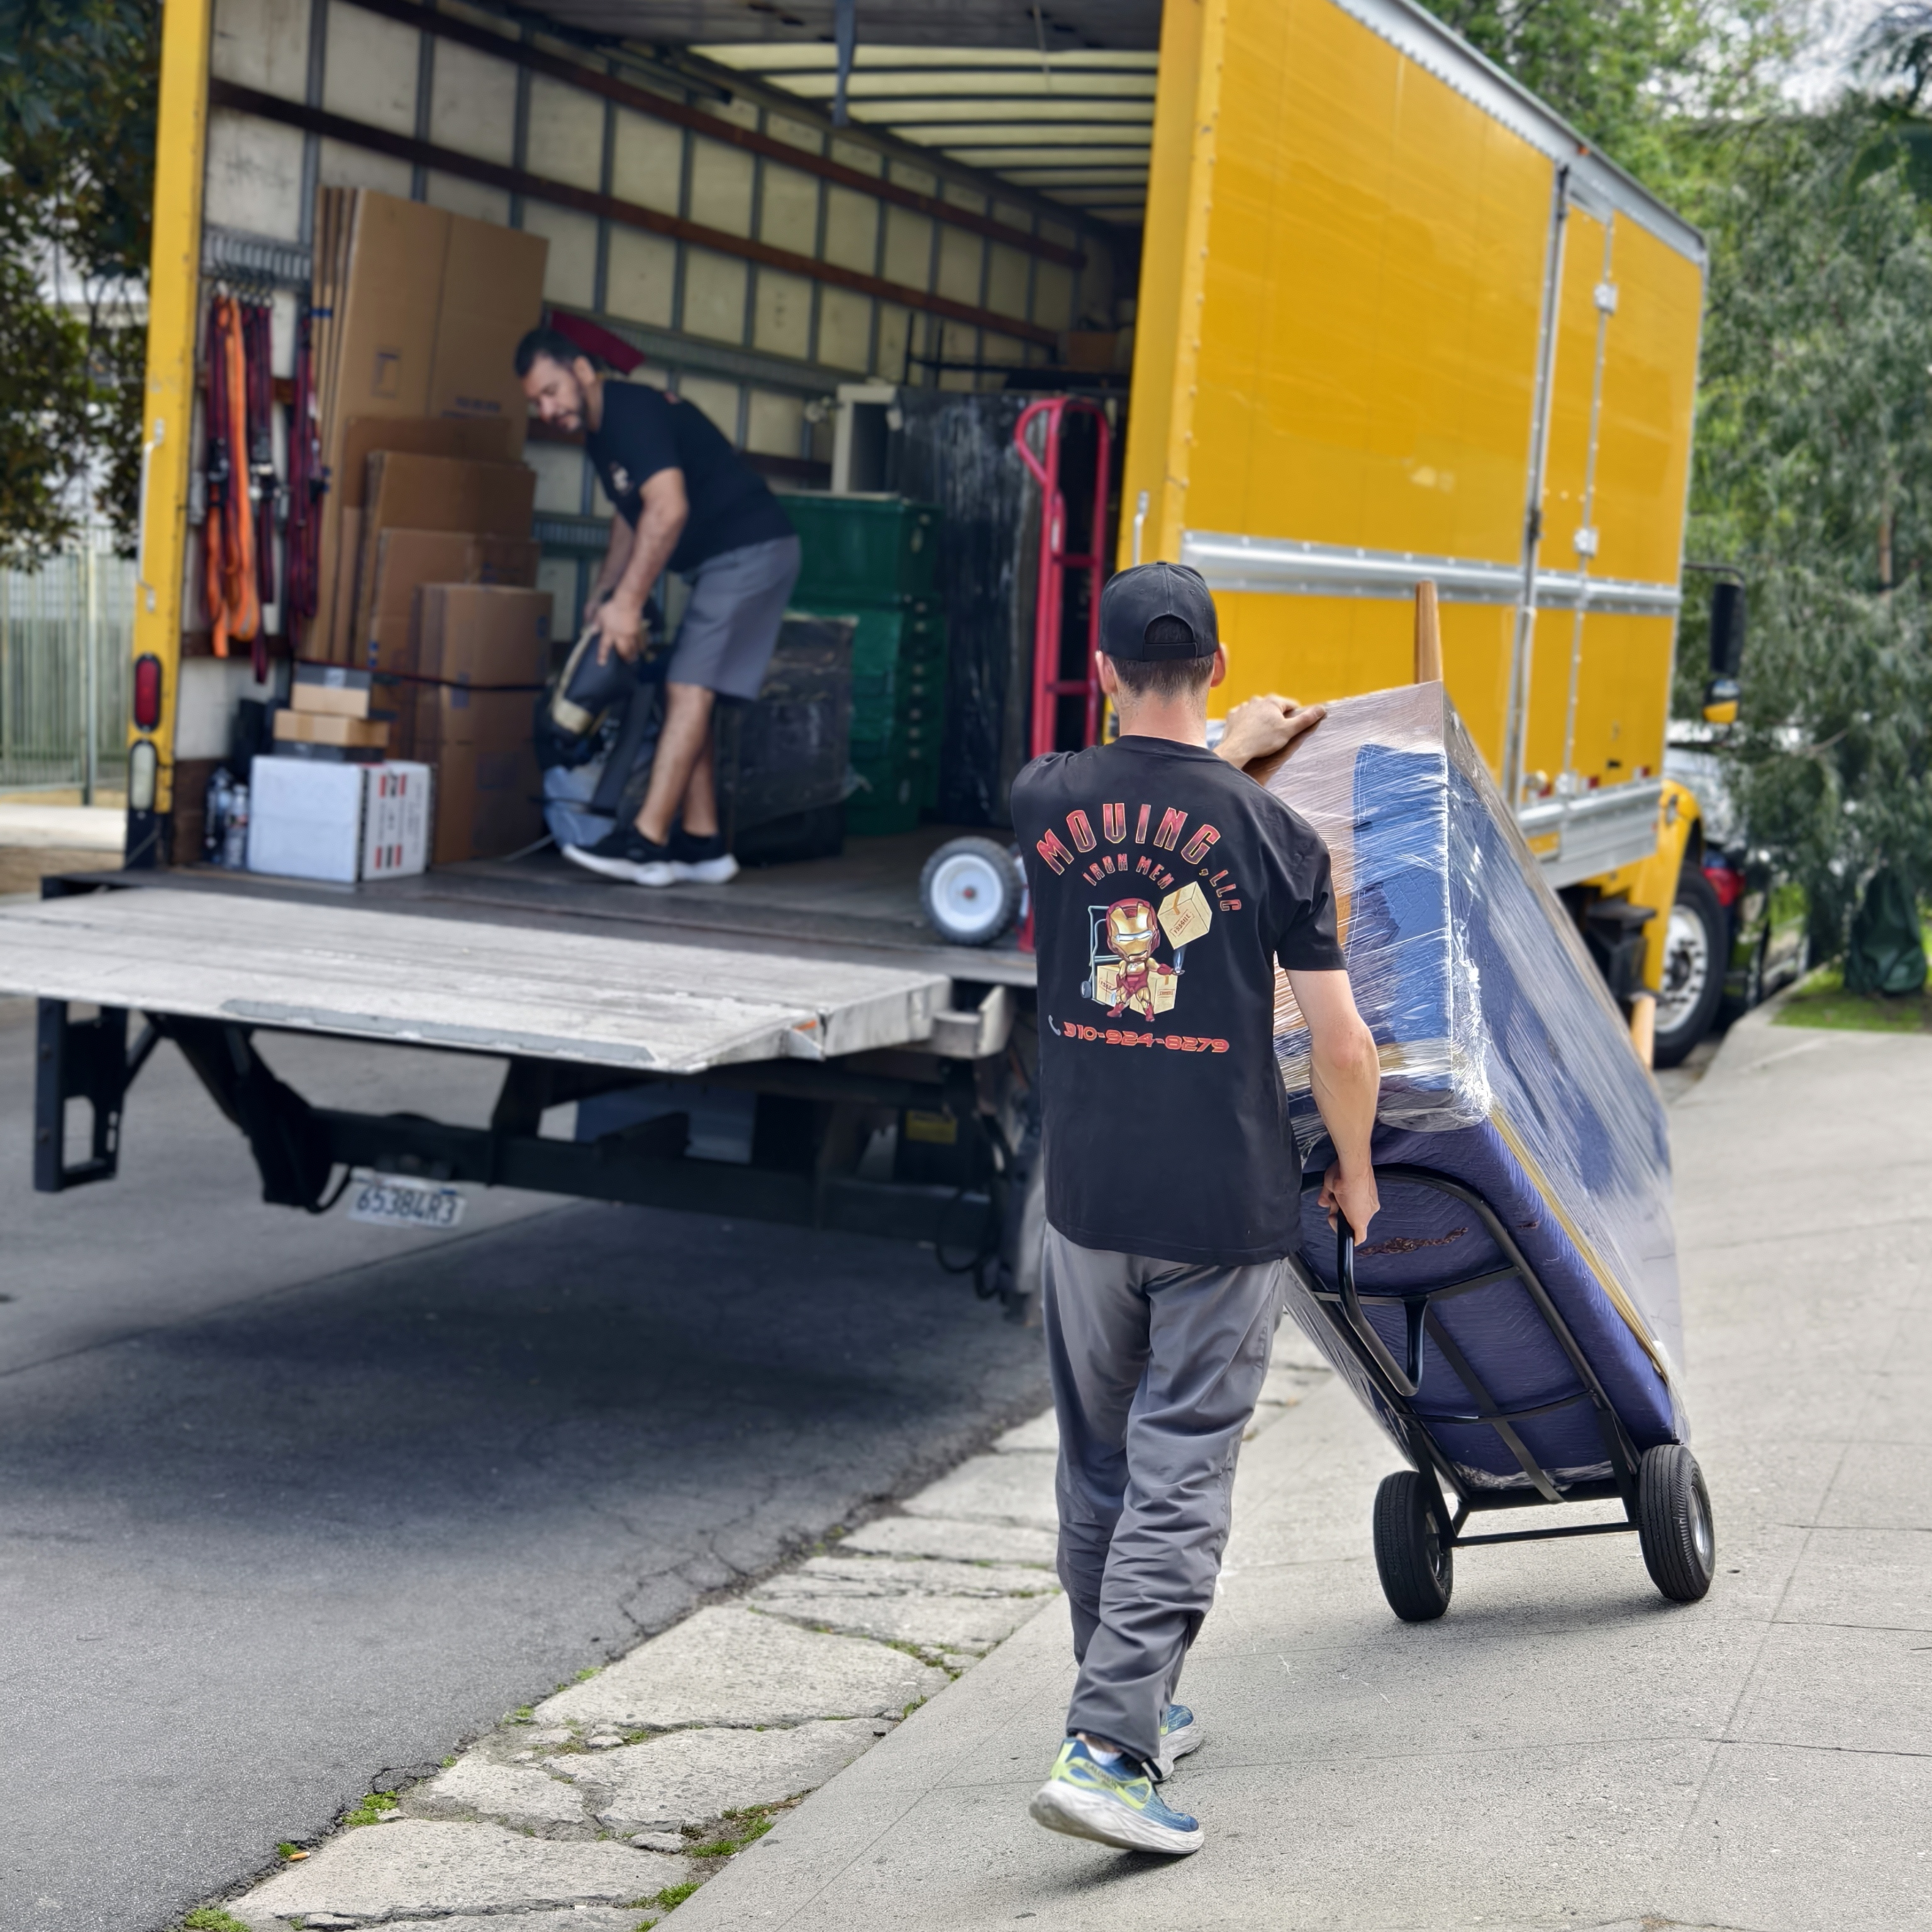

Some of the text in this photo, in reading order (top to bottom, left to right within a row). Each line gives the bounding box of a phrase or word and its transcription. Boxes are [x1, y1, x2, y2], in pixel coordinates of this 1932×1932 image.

[1082, 853, 1175, 890] IRON MEN
[1209, 869, 1242, 911] LLC
[1063, 1021, 1230, 1053] 310-924-8279
